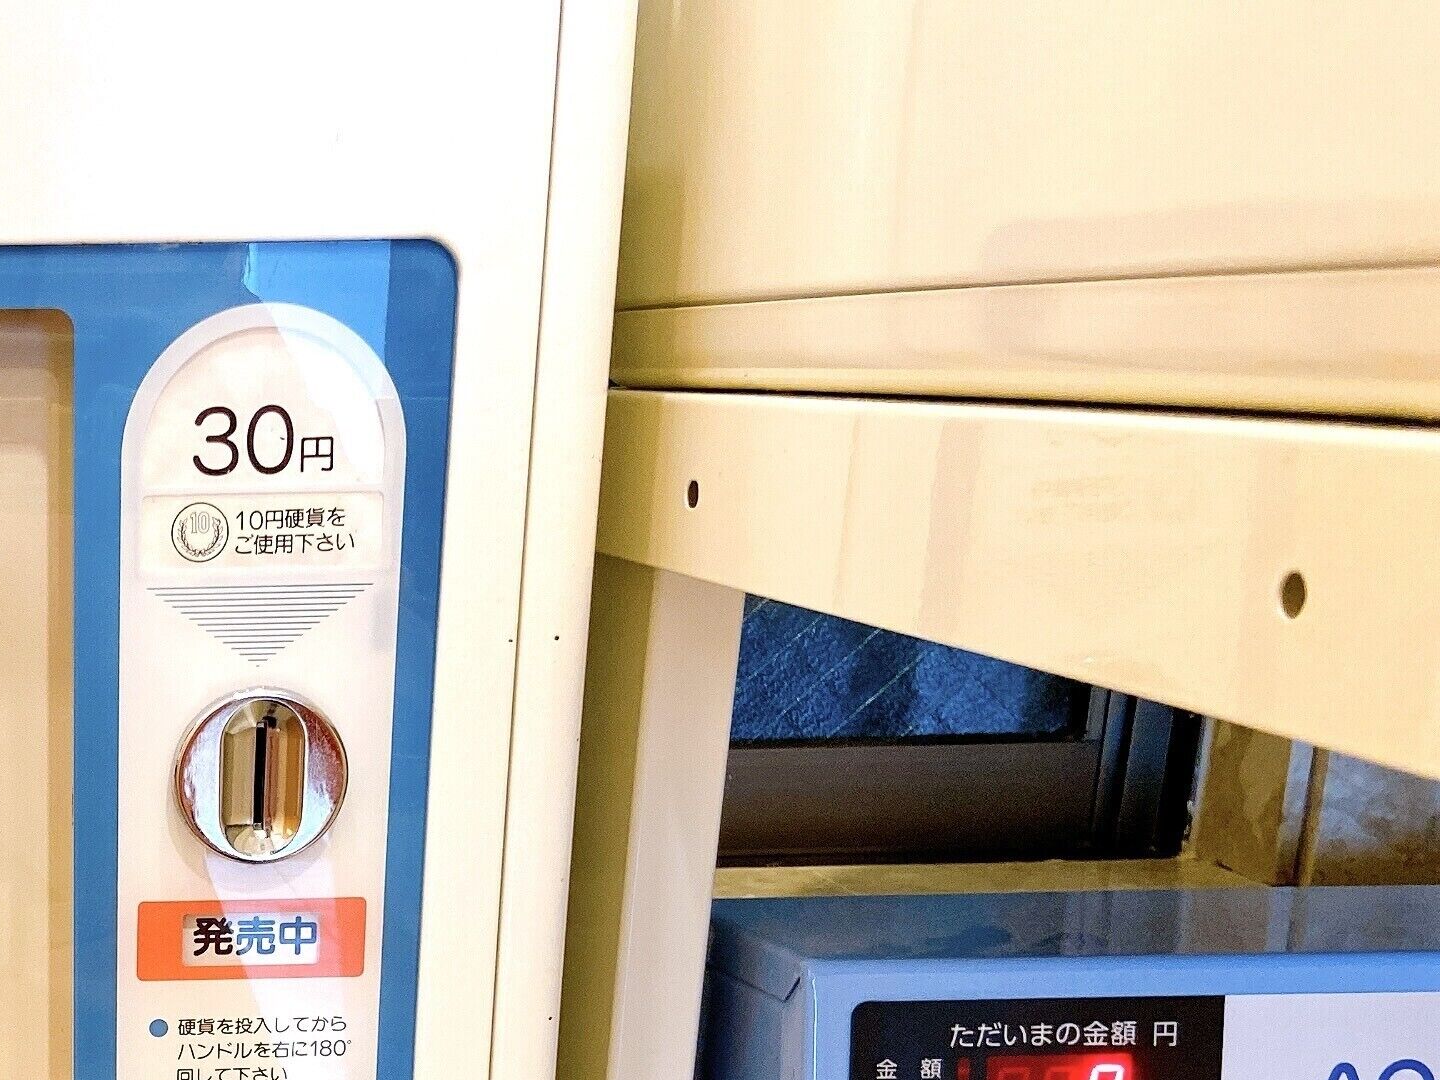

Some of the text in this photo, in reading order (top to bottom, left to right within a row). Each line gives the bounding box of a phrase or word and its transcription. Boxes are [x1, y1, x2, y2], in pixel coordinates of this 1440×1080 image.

[192, 404, 334, 477] 30円
[234, 506, 346, 531] 10円硬貨を
[234, 530, 356, 556] ご使用下さい
[193, 914, 318, 957] 発売中
[177, 1014, 348, 1038] 硬貨を投入してから
[950, 1020, 1179, 1049] ただいまの金額 円
